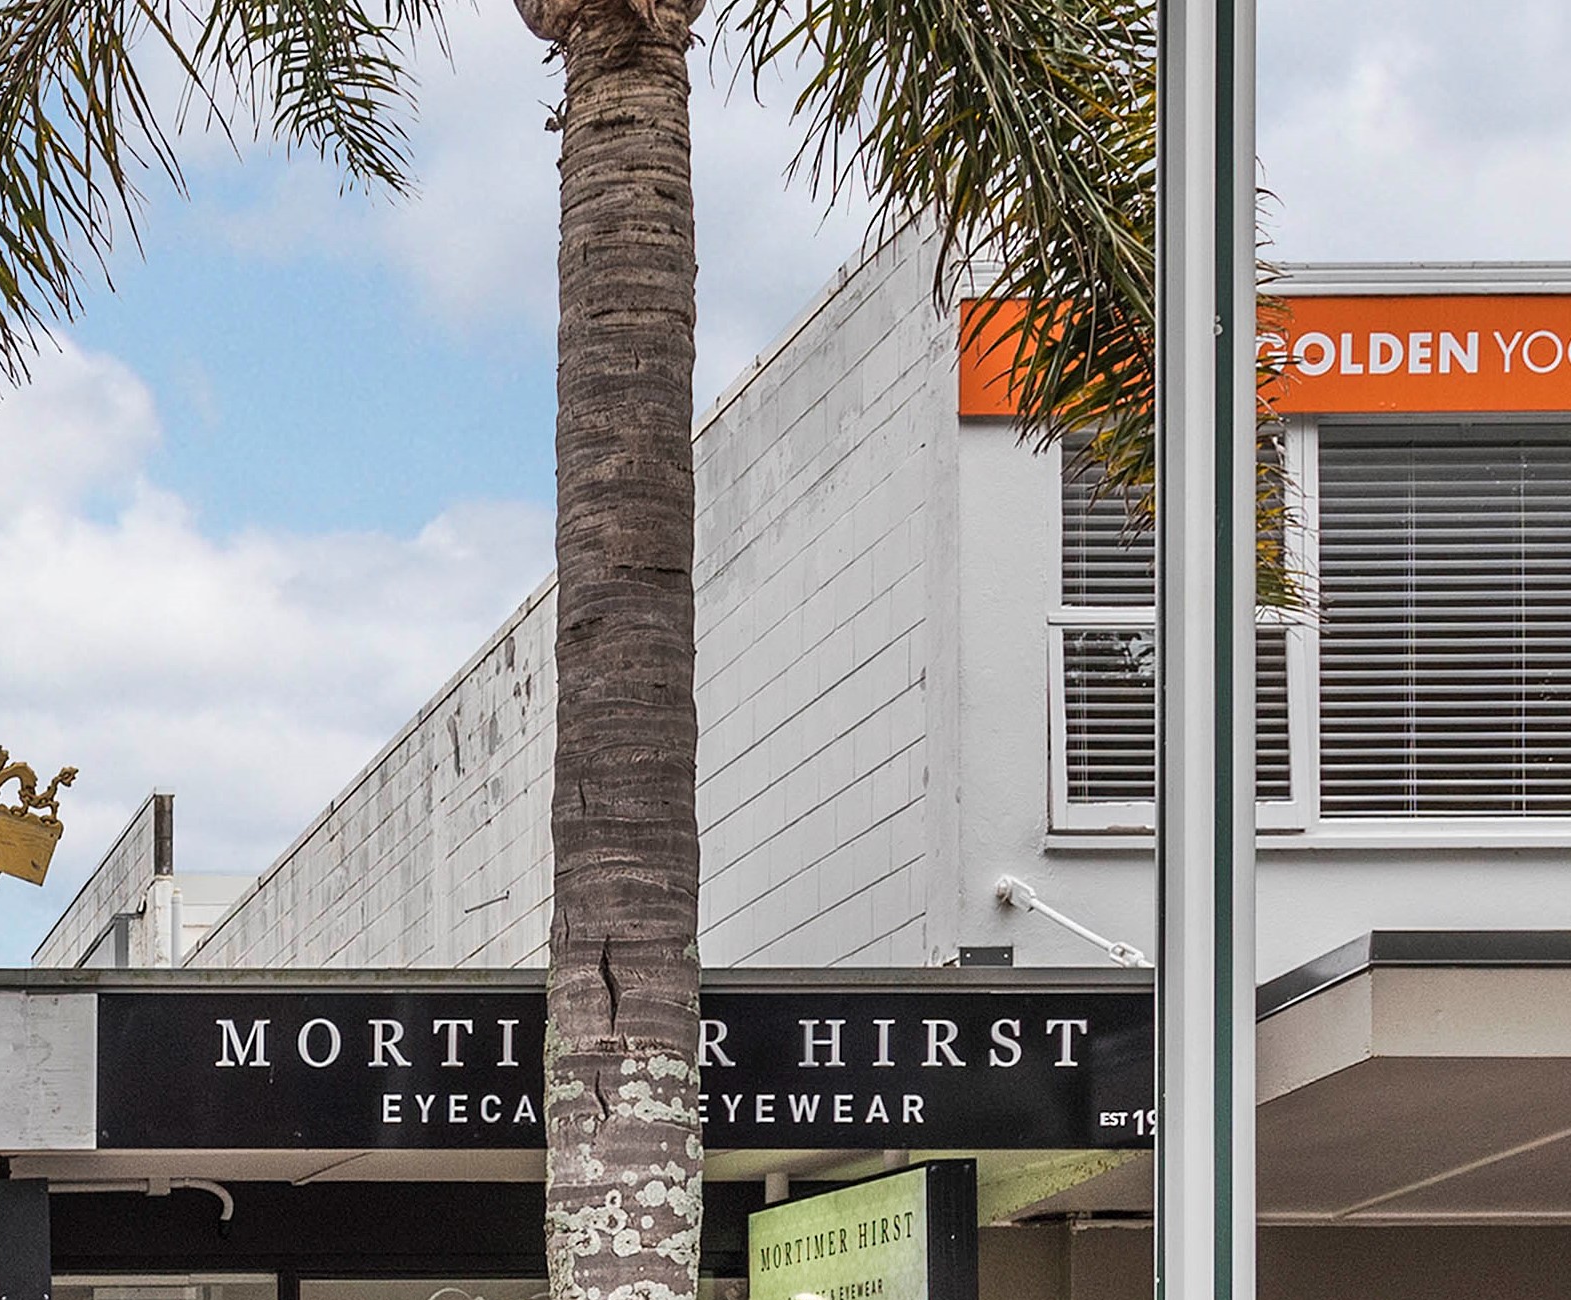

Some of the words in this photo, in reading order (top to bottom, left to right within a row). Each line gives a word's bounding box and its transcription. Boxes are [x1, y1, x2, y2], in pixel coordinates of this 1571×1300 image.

[1493, 330, 1571, 373] YO
[215, 1018, 736, 1068] MORTIR
[798, 1018, 1088, 1068] HIRST
[382, 1094, 537, 1123] EYECA
[698, 1093, 926, 1123] EYEWEAR
[1099, 1112, 1129, 1127] EST
[1133, 1109, 1156, 1136] 19
[760, 1227, 848, 1272] MORTIMER
[858, 1211, 914, 1250] HIRST
